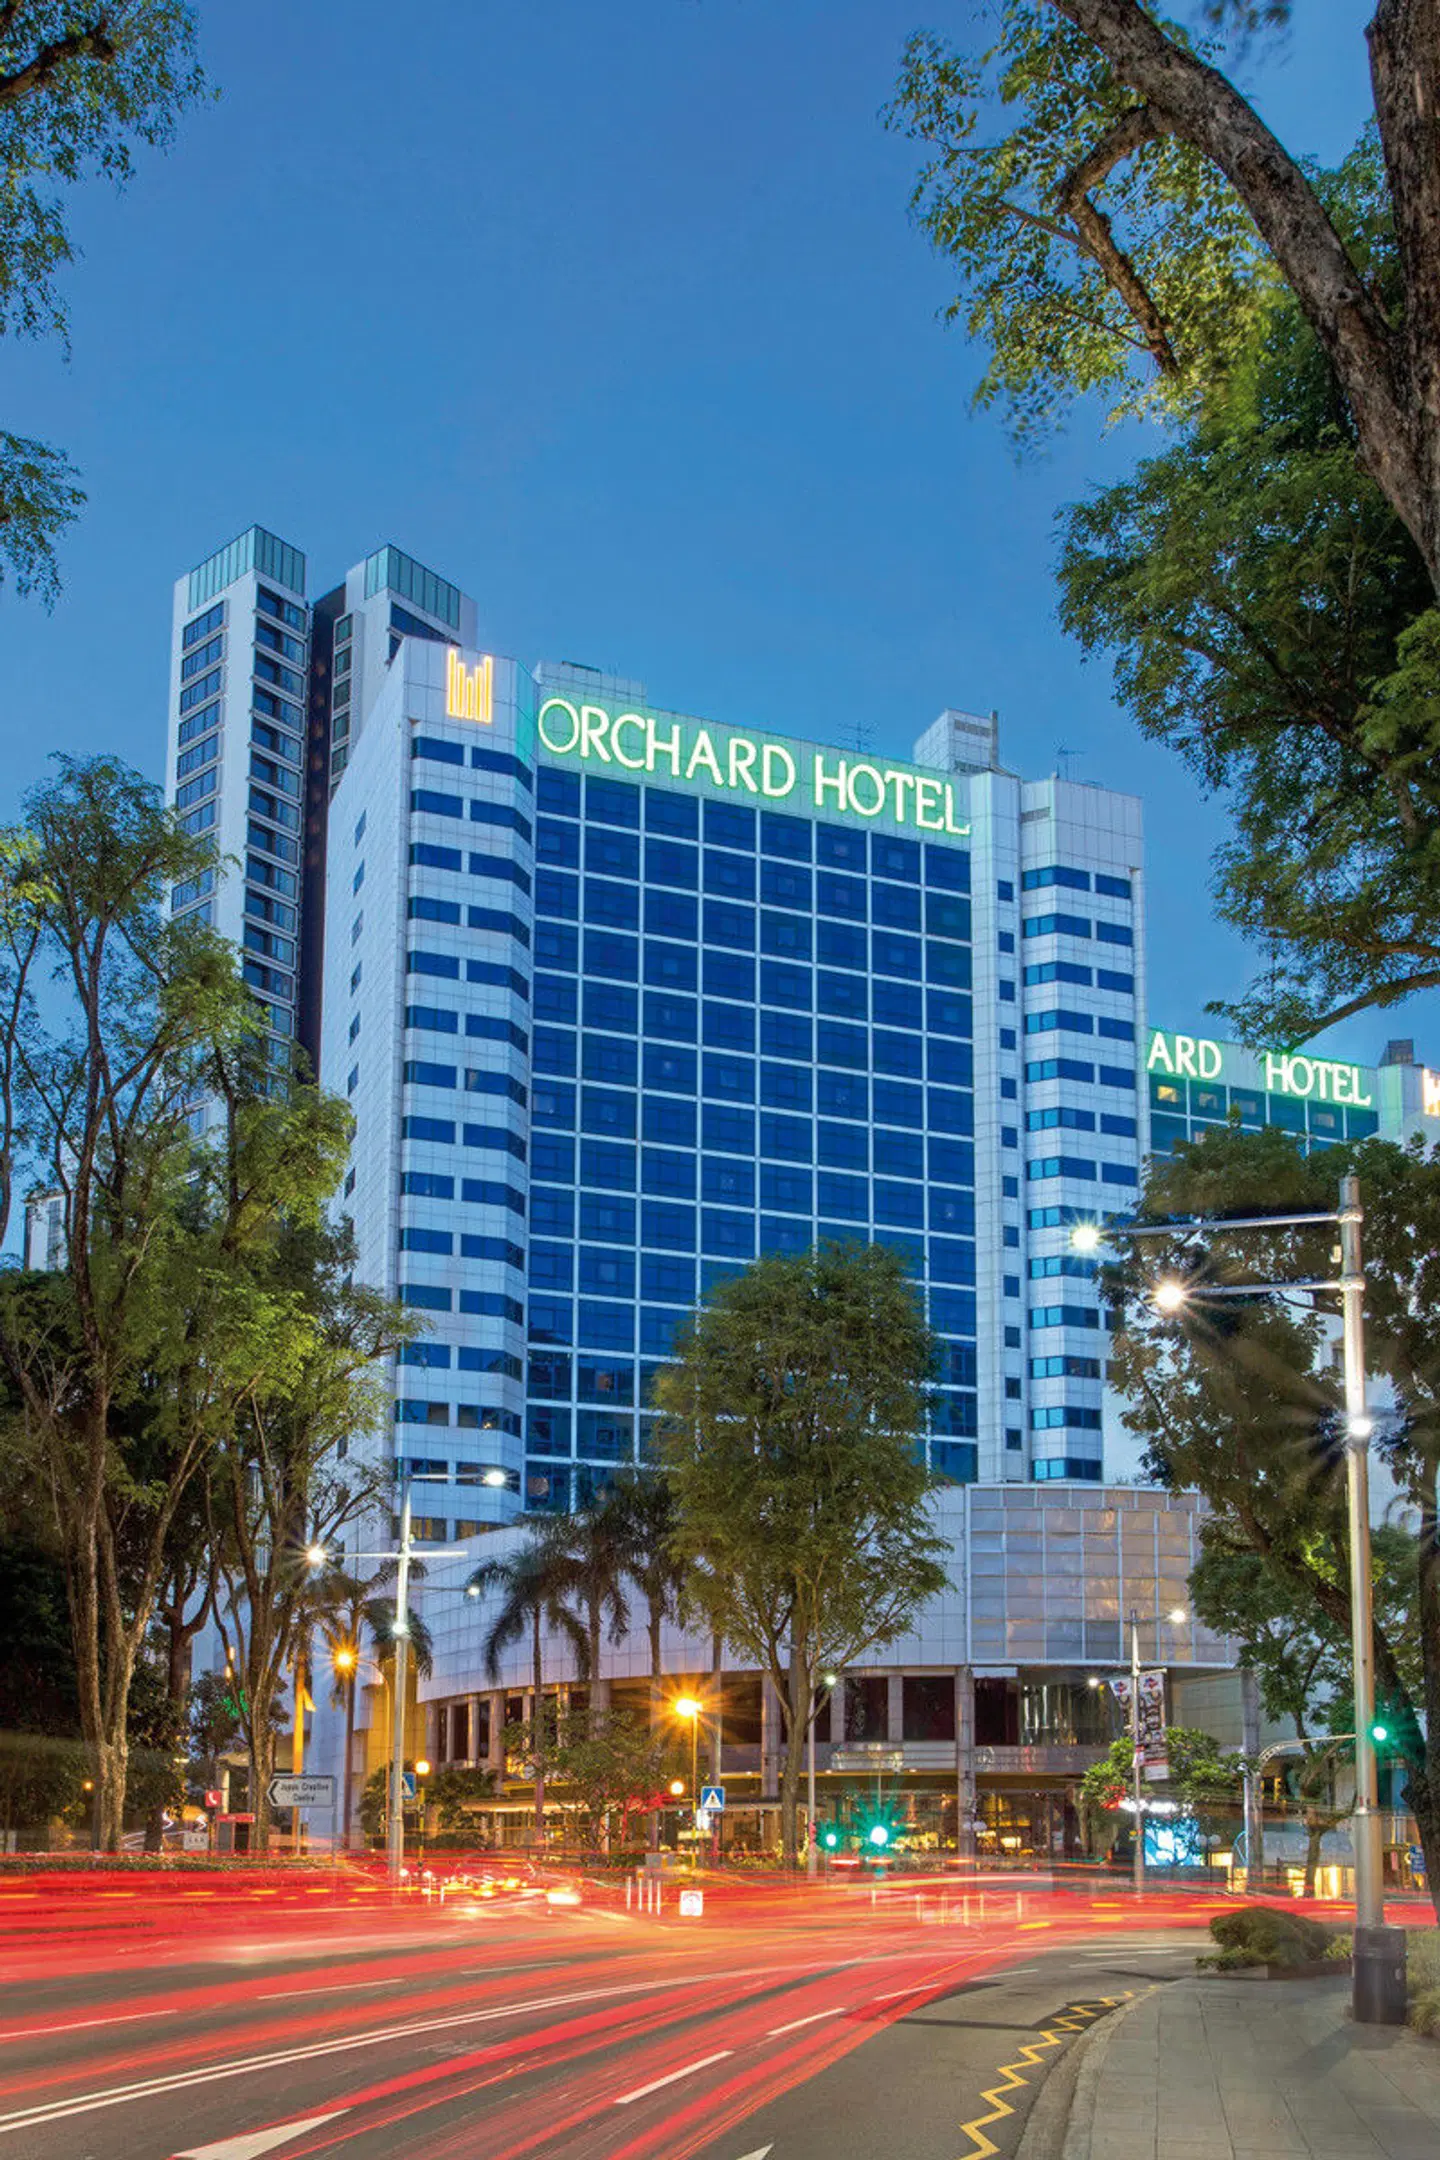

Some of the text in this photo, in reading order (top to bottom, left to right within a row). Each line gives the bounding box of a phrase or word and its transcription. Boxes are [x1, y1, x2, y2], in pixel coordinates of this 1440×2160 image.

[537, 697, 971, 835] ORCHARD HOTEL
[1265, 1051, 1371, 1106] HOTEL
